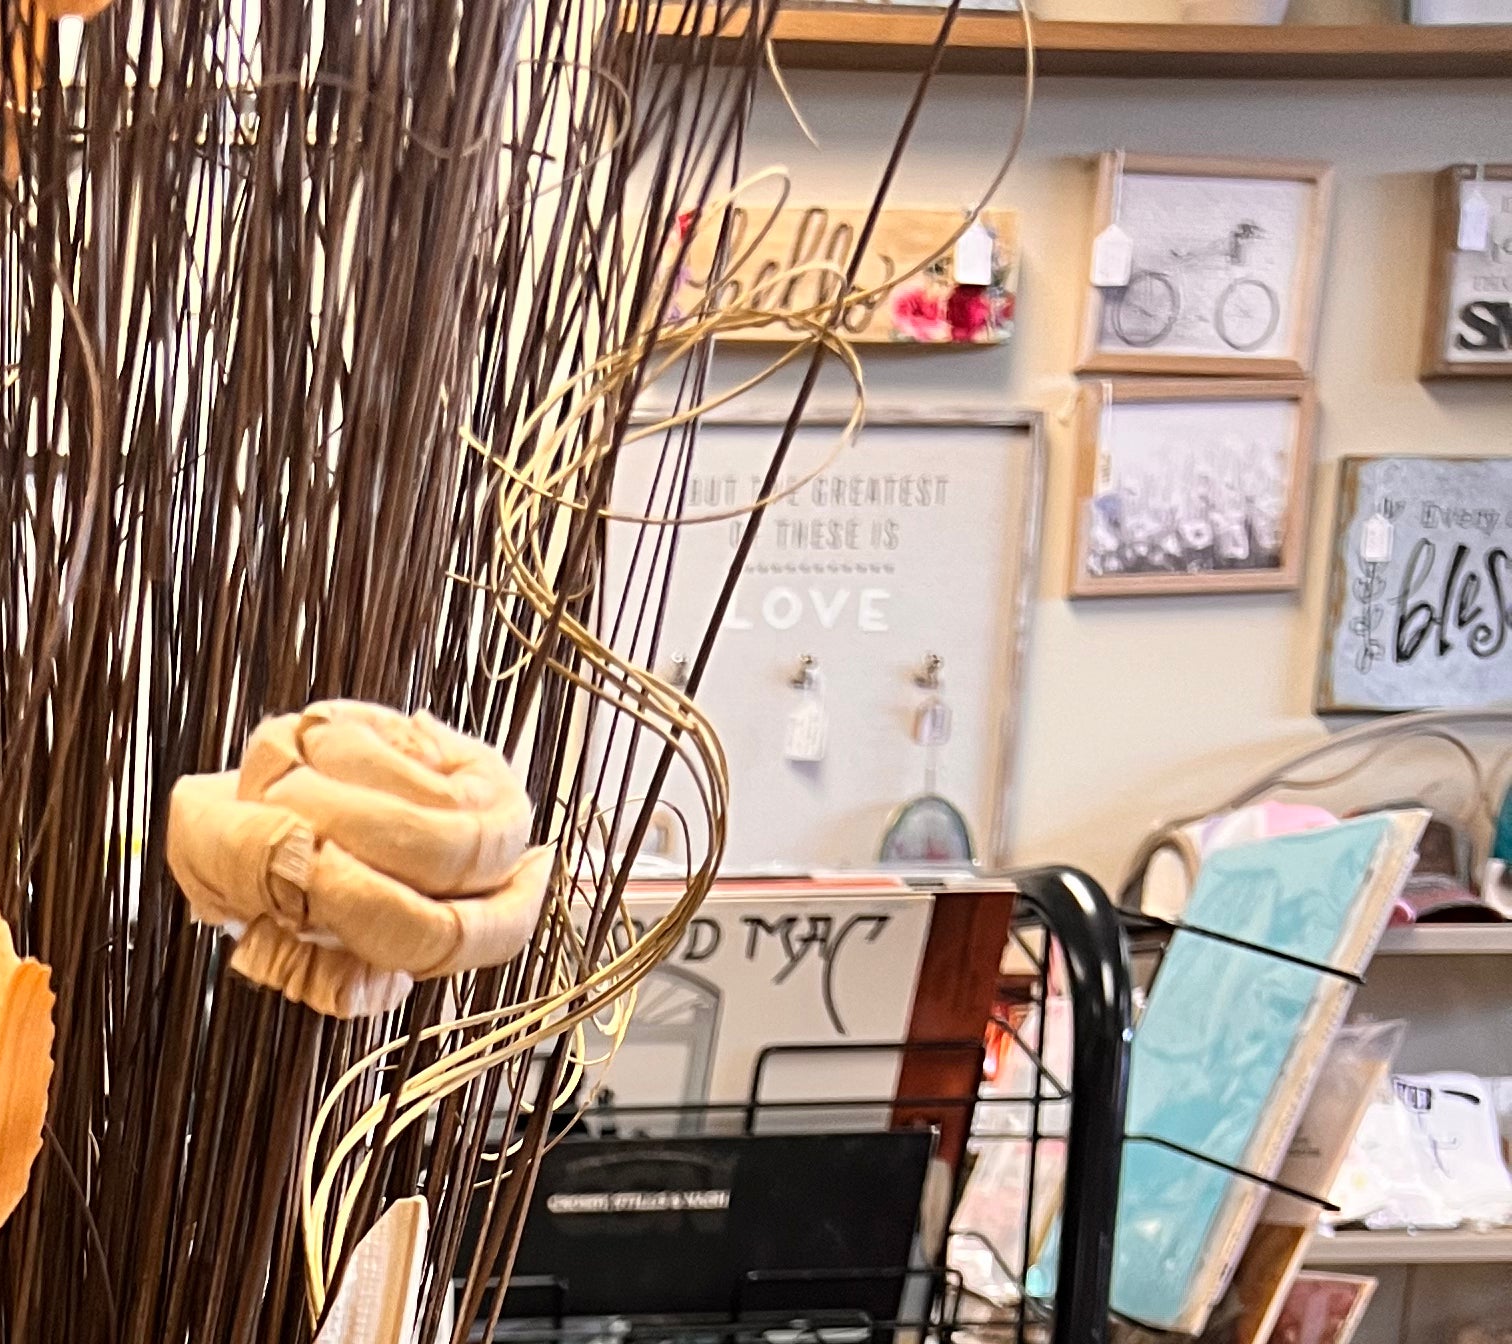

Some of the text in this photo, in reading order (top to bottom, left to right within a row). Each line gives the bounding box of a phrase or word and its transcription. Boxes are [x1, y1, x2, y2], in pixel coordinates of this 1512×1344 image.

[811, 473, 950, 506] GREATEST
[776, 518, 861, 550] THESE
[869, 518, 900, 550] IS
[723, 586, 892, 632] LOVE
[1394, 537, 1512, 664] bles
